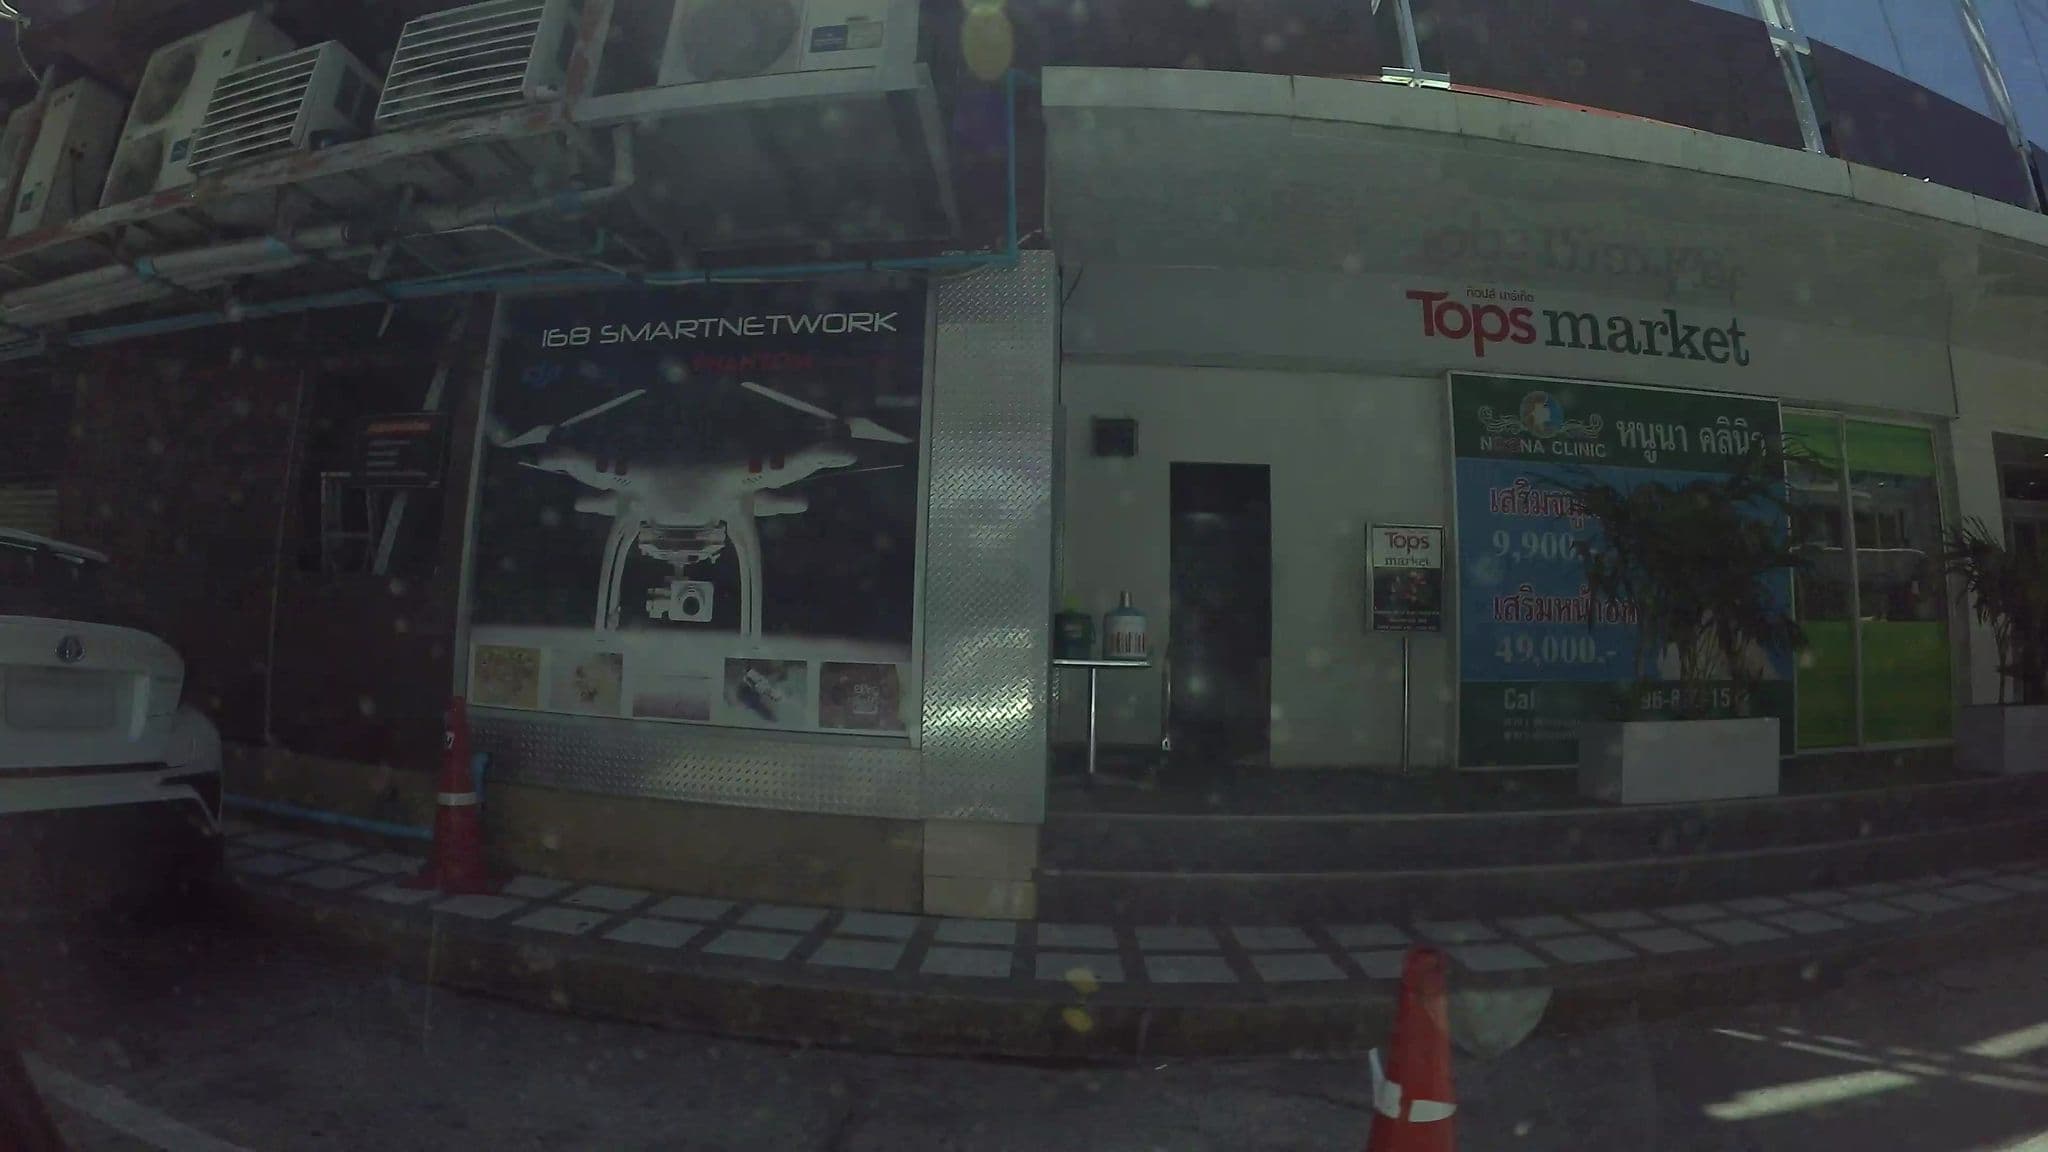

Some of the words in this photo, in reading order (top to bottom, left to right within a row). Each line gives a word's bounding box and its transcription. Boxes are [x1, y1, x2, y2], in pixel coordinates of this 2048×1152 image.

[541, 327, 591, 348] 168
[599, 311, 898, 345] SMARTNETWORK
[1406, 289, 1537, 357] Tops
[1542, 308, 1750, 366] market
[1480, 435, 1545, 454] NNA
[1552, 440, 1607, 458] CLINIC
[1615, 415, 1688, 463] หนูนา
[1384, 531, 1430, 554] Tops
[1385, 555, 1432, 567] market
[1494, 634, 1617, 668] 49,000.-
